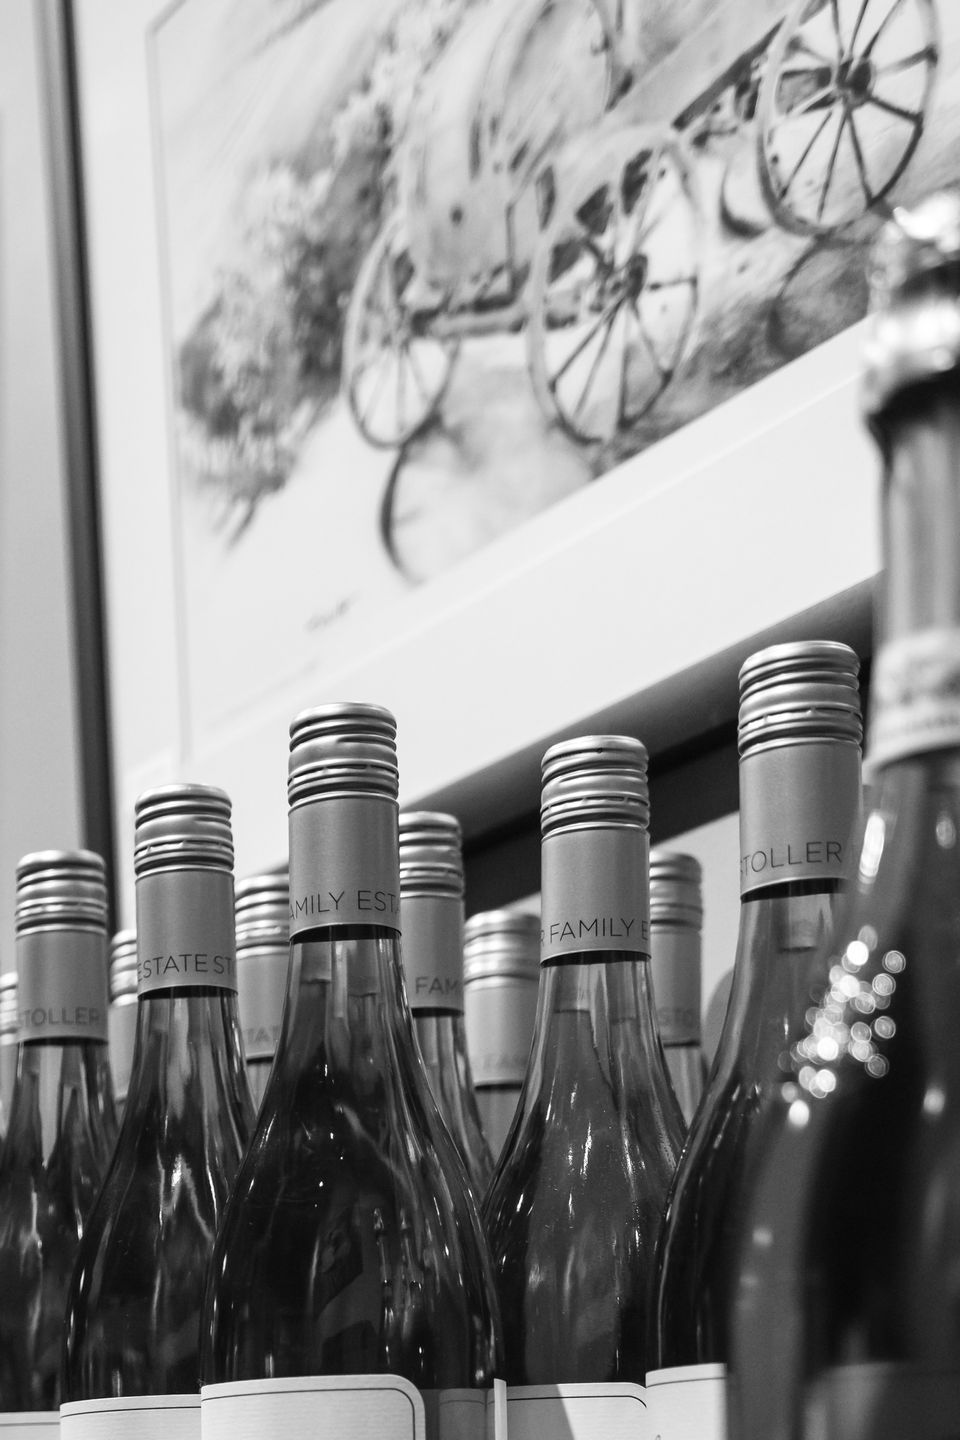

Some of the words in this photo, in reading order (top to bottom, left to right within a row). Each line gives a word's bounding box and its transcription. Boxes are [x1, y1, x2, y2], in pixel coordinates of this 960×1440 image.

[740, 841, 843, 876] TOLLER
[549, 917, 635, 942] FAMILY
[415, 975, 461, 995] FAM
